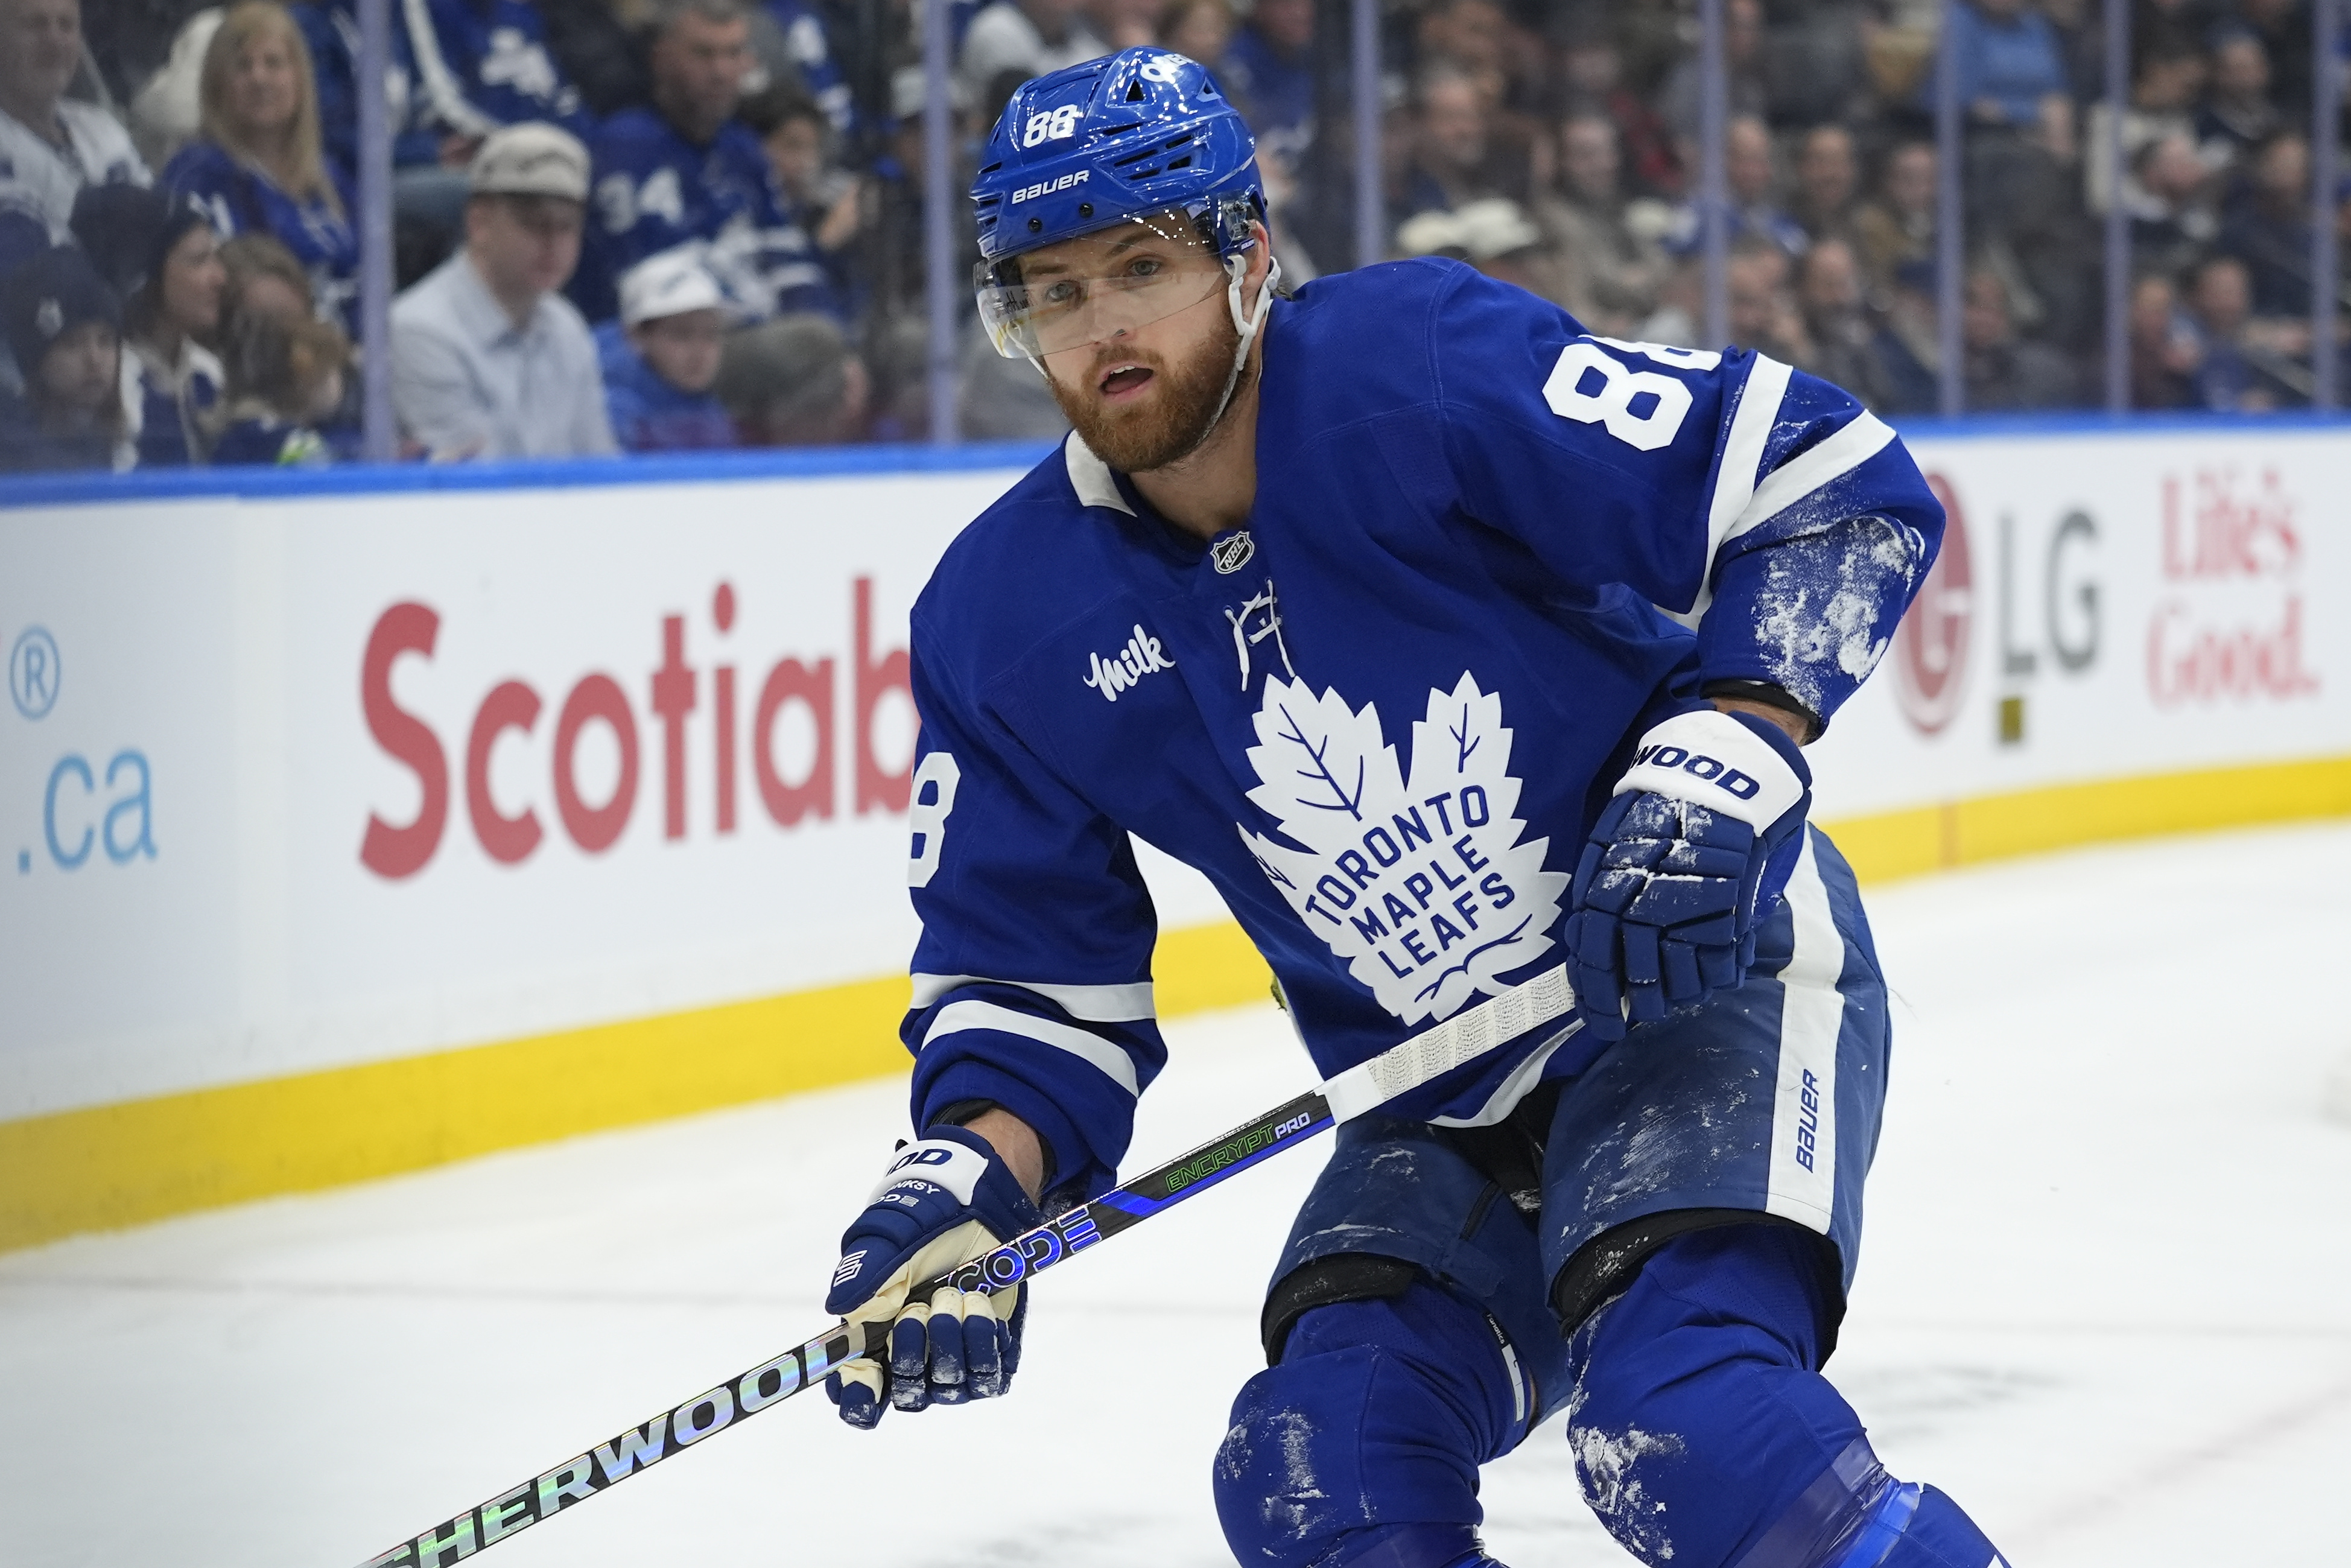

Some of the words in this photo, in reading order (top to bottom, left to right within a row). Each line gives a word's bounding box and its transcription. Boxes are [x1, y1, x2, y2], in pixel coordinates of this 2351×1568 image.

[1023, 104, 1078, 148] 88
[1012, 169, 1090, 205] BAUER
[1223, 541, 1246, 568] NHL
[1997, 509, 2099, 674] LG
[359, 576, 921, 880] Scotiab
[1305, 785, 1490, 926] TORONTO
[1349, 834, 1490, 945] MAPLE
[1377, 872, 1515, 979] LEAFS
[886, 1148, 953, 1177] OD
[1164, 1122, 1277, 1193] ENCRYPT
[1274, 1111, 1311, 1140] PRO
[1796, 1068, 1820, 1173] BAUER
[948, 1206, 1103, 1295] CODE
